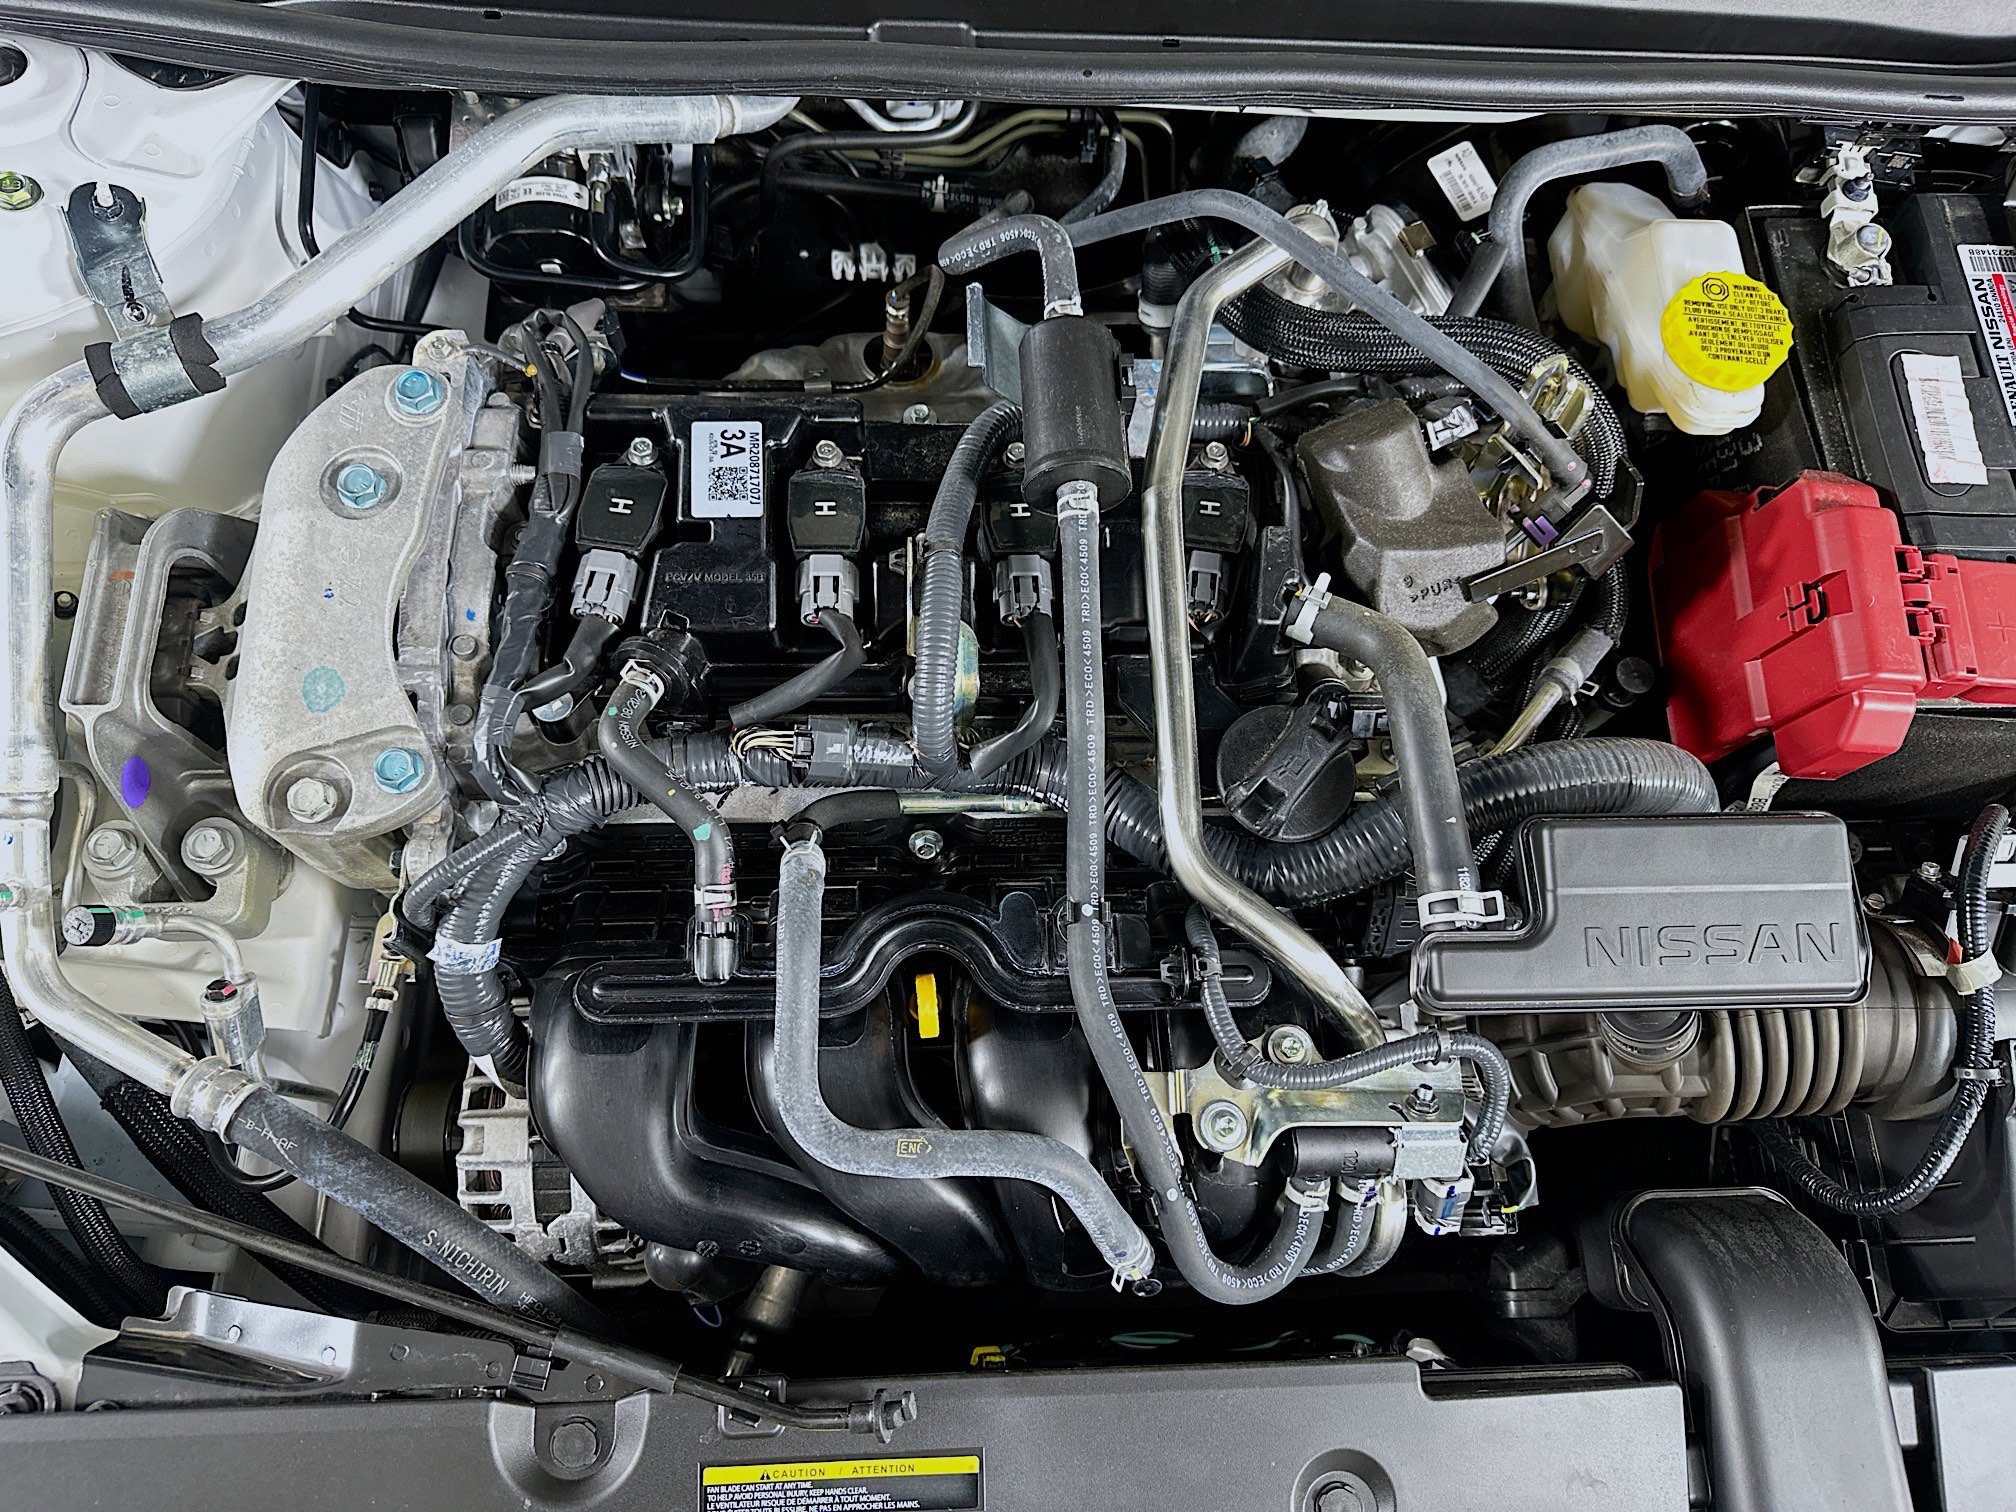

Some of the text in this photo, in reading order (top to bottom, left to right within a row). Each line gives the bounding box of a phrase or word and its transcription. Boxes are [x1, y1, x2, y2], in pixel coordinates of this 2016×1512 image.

[1733, 291, 1775, 301] CLEAN FILLER
[1729, 311, 1752, 319] SEALED
[1754, 314, 1786, 322] CONTAINER
[1765, 307, 1785, 316] BRAKE
[1972, 278, 2005, 350] NISSAN
[1695, 324, 1722, 332] BOUCHON
[1733, 328, 1774, 338] REMPLISSAGE
[1741, 322, 1772, 330] NETTOYER
[1701, 338, 1736, 347] SEULEMENT
[1708, 353, 1743, 362] CONTENANT
[1720, 347, 1755, 356] PROVENANT
[720, 429, 746, 459] 3A
[749, 432, 761, 505] MR20871707J
[609, 498, 633, 514] H
[814, 501, 837, 516] H
[1009, 503, 1031, 517] H
[1199, 500, 1221, 516] H
[704, 573, 742, 582] MODEL
[1078, 538, 1091, 623] TRD>ECO<4509
[1082, 629, 1096, 726] TRD>ECO<4509
[618, 720, 641, 750] NISSAN
[1088, 734, 1098, 826] TRD>ECO<4509
[1584, 922, 1844, 967] NISSAN
[773, 1468, 826, 1479] CAUTION
[852, 1464, 915, 1475] ATTENTION
[755, 1483, 774, 1491] START
[775, 1482, 784, 1490] AT
[715, 1500, 760, 1509] VENTILATEUR
[761, 1499, 785, 1507] RISQUE
[797, 1496, 834, 1504] DÉMARRER
[834, 1495, 840, 1503] À
[753, 1491, 786, 1499] PERSONAL
[819, 1504, 832, 1512] PAS
[843, 1502, 884, 1511] APPROCHER
[884, 1501, 895, 1509] LES
[896, 1500, 920, 1508] MAINS.
